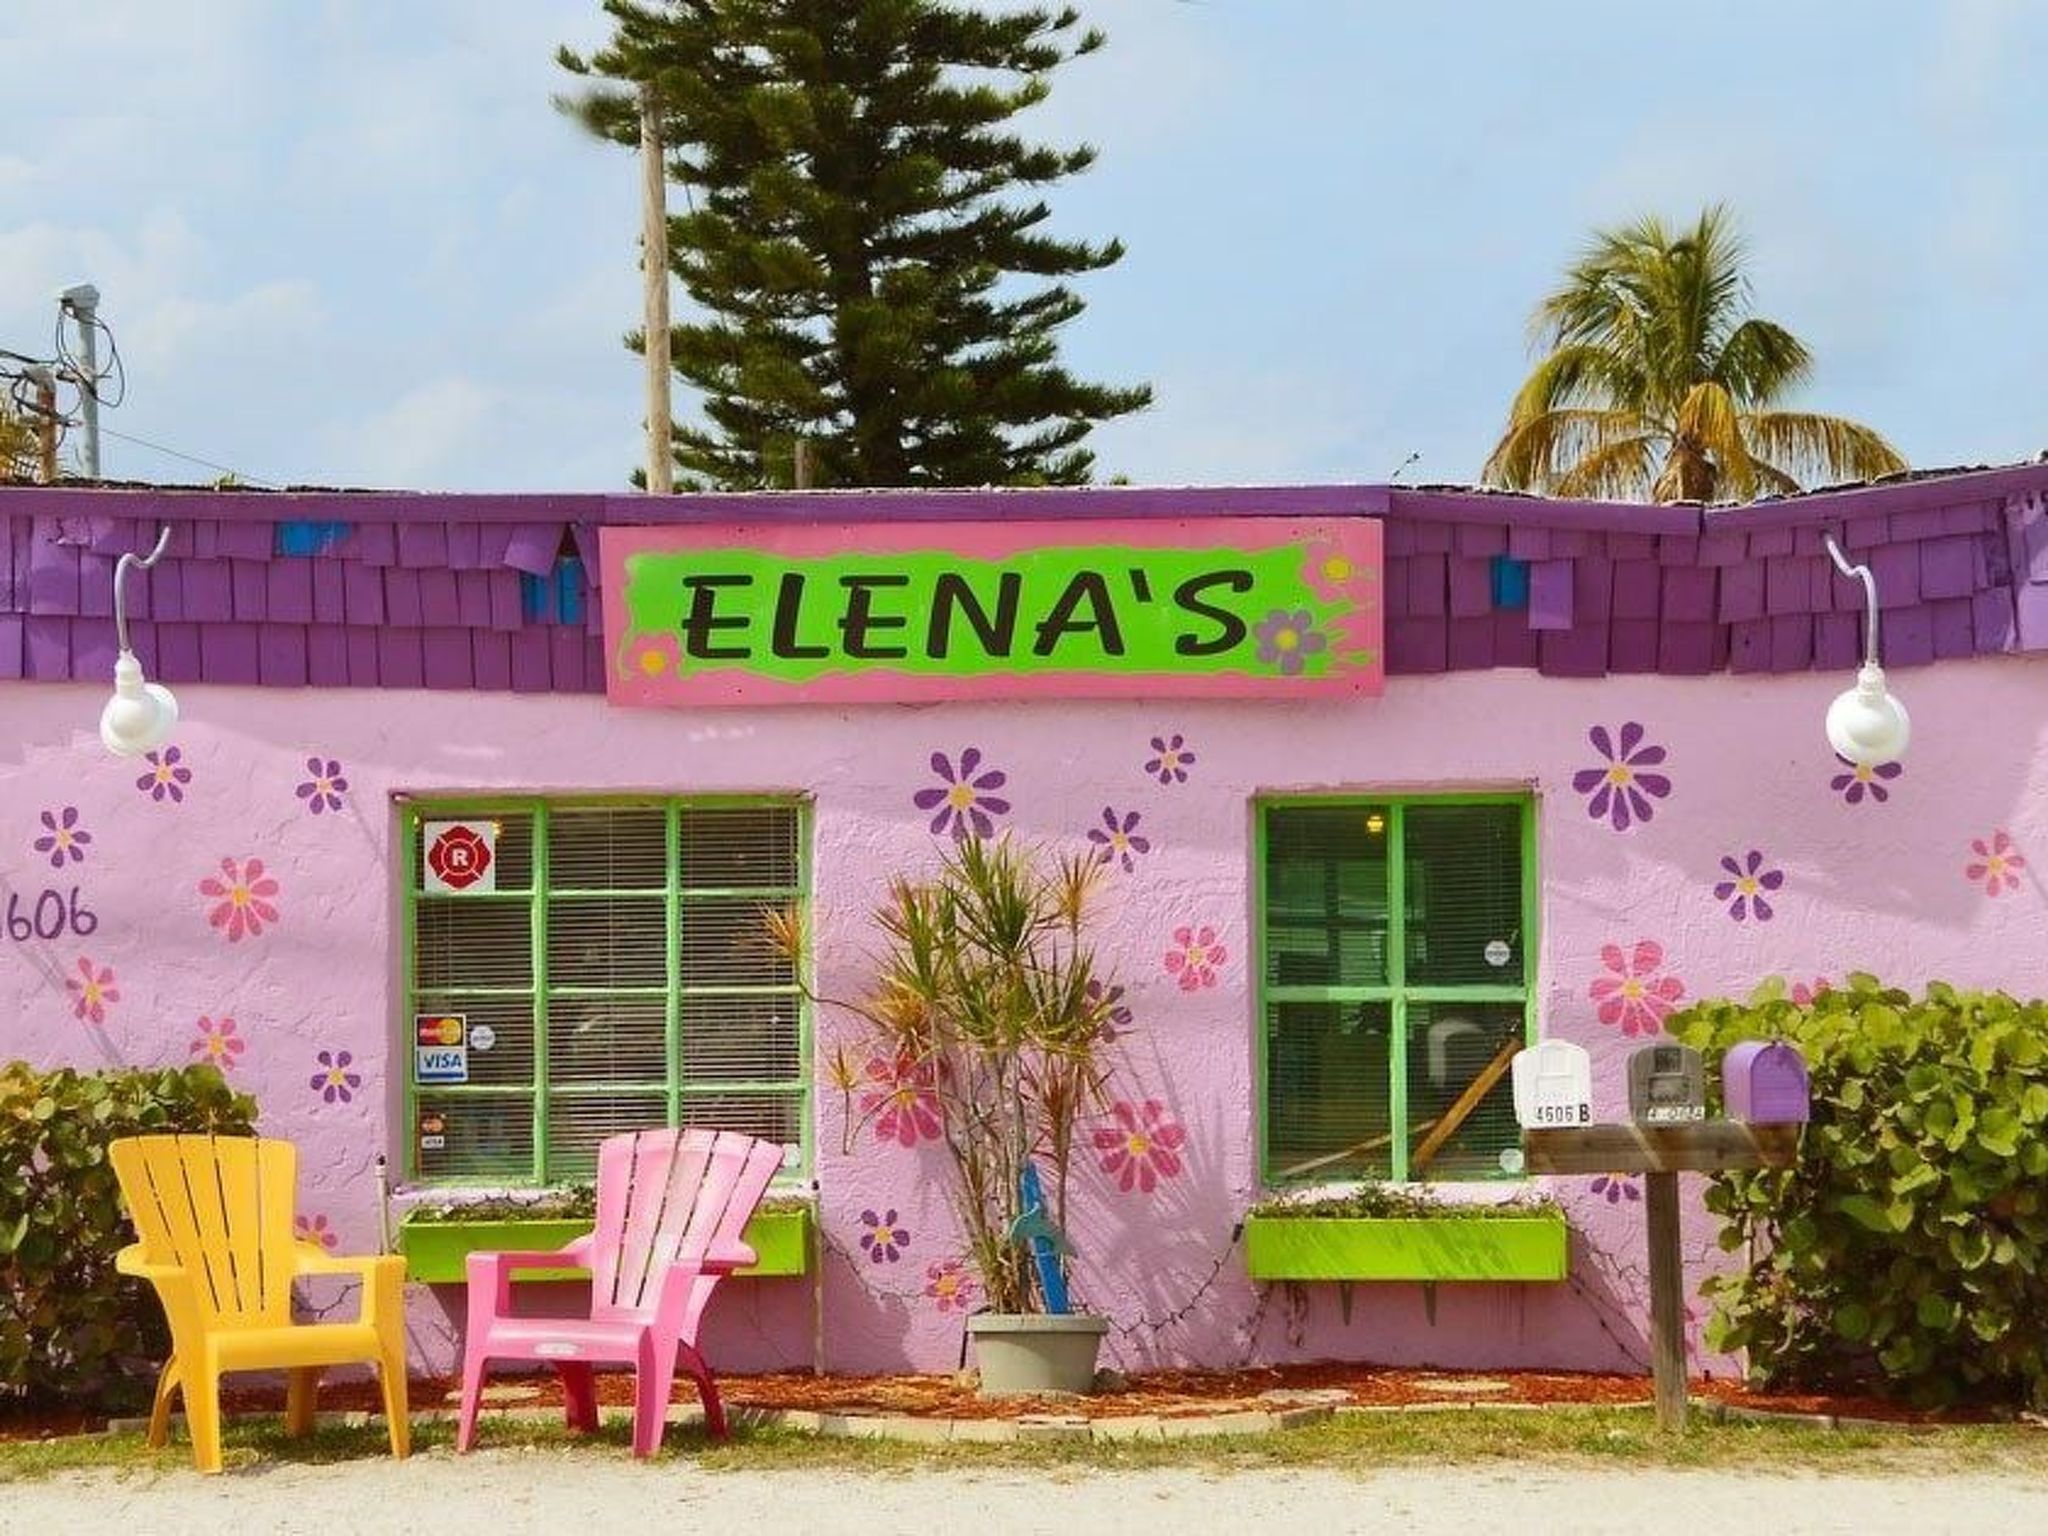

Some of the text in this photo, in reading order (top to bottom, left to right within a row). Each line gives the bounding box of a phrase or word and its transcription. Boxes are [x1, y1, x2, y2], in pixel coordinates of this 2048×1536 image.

[682, 567, 1255, 660] ELENA'S
[452, 848, 469, 866] R
[0, 885, 98, 941] 606
[424, 1053, 462, 1069] VISA
[1536, 1103, 1590, 1122] 4606 B
